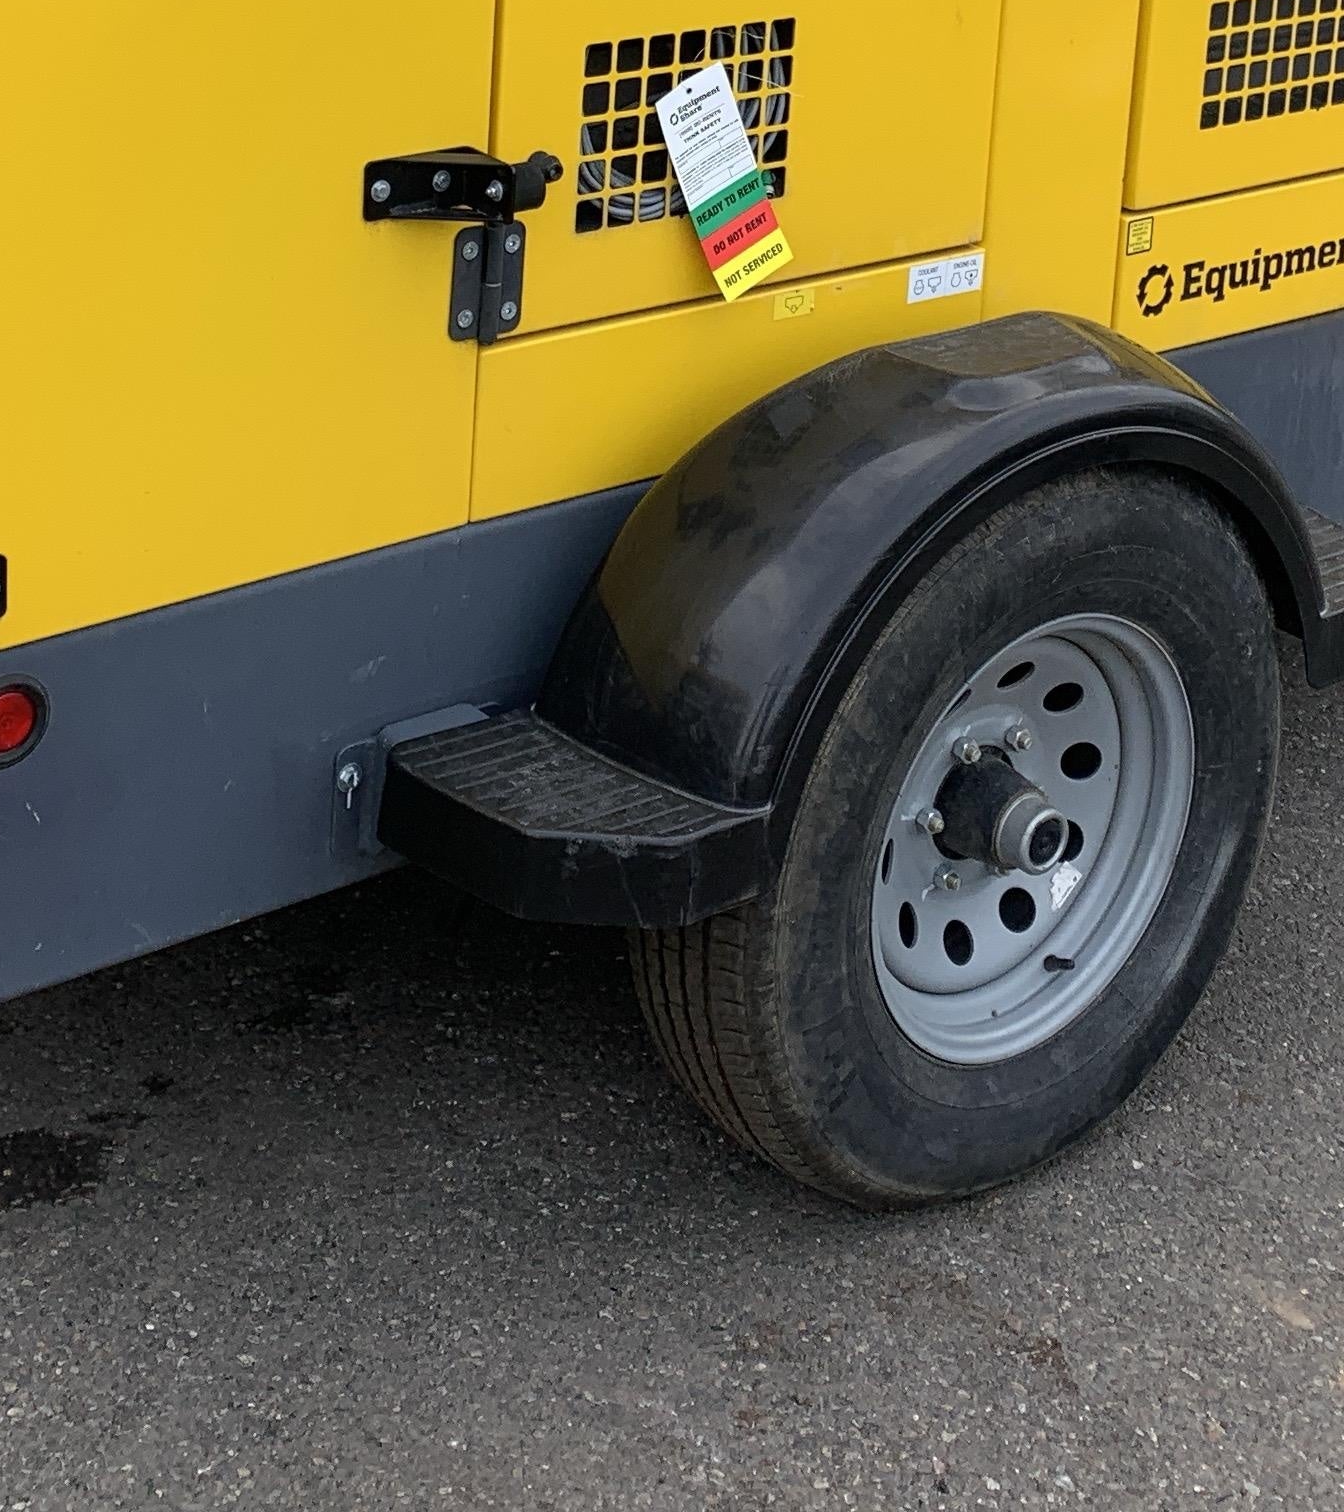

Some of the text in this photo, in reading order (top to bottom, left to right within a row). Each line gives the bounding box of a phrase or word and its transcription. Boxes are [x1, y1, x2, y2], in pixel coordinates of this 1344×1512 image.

[676, 86, 721, 114] Equipment
[679, 104, 703, 122] Share
[696, 177, 760, 227] READY TO RENT
[713, 211, 767, 255] DO NOT RENT
[724, 242, 783, 288] NOT SERVICED
